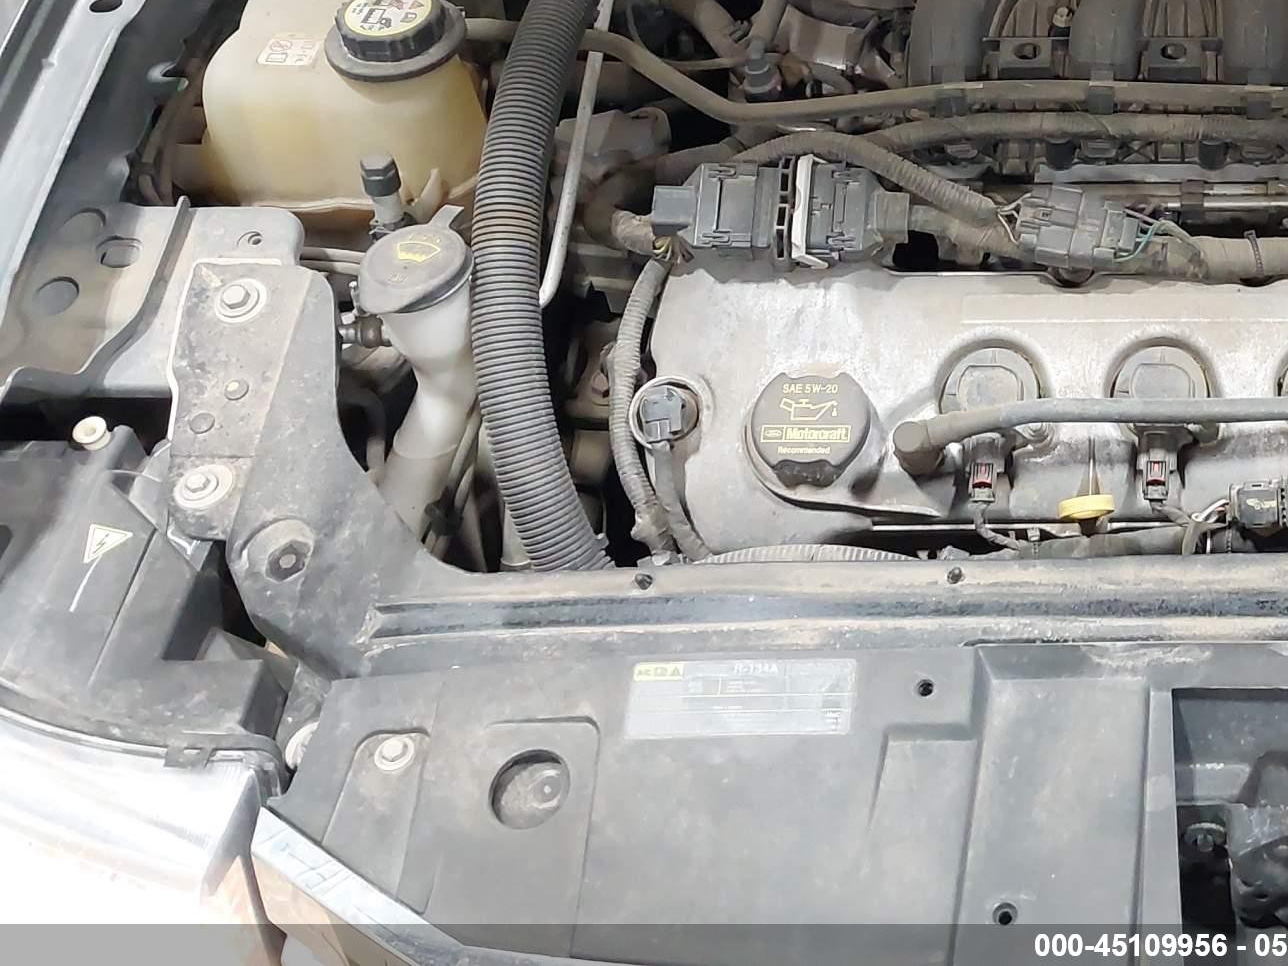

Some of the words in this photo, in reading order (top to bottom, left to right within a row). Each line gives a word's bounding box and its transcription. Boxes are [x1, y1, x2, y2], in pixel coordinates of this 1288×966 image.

[783, 384, 803, 394] SAE
[805, 384, 838, 394] 5W-20
[785, 427, 848, 440] Motorcraft
[777, 445, 831, 454] Recommended
